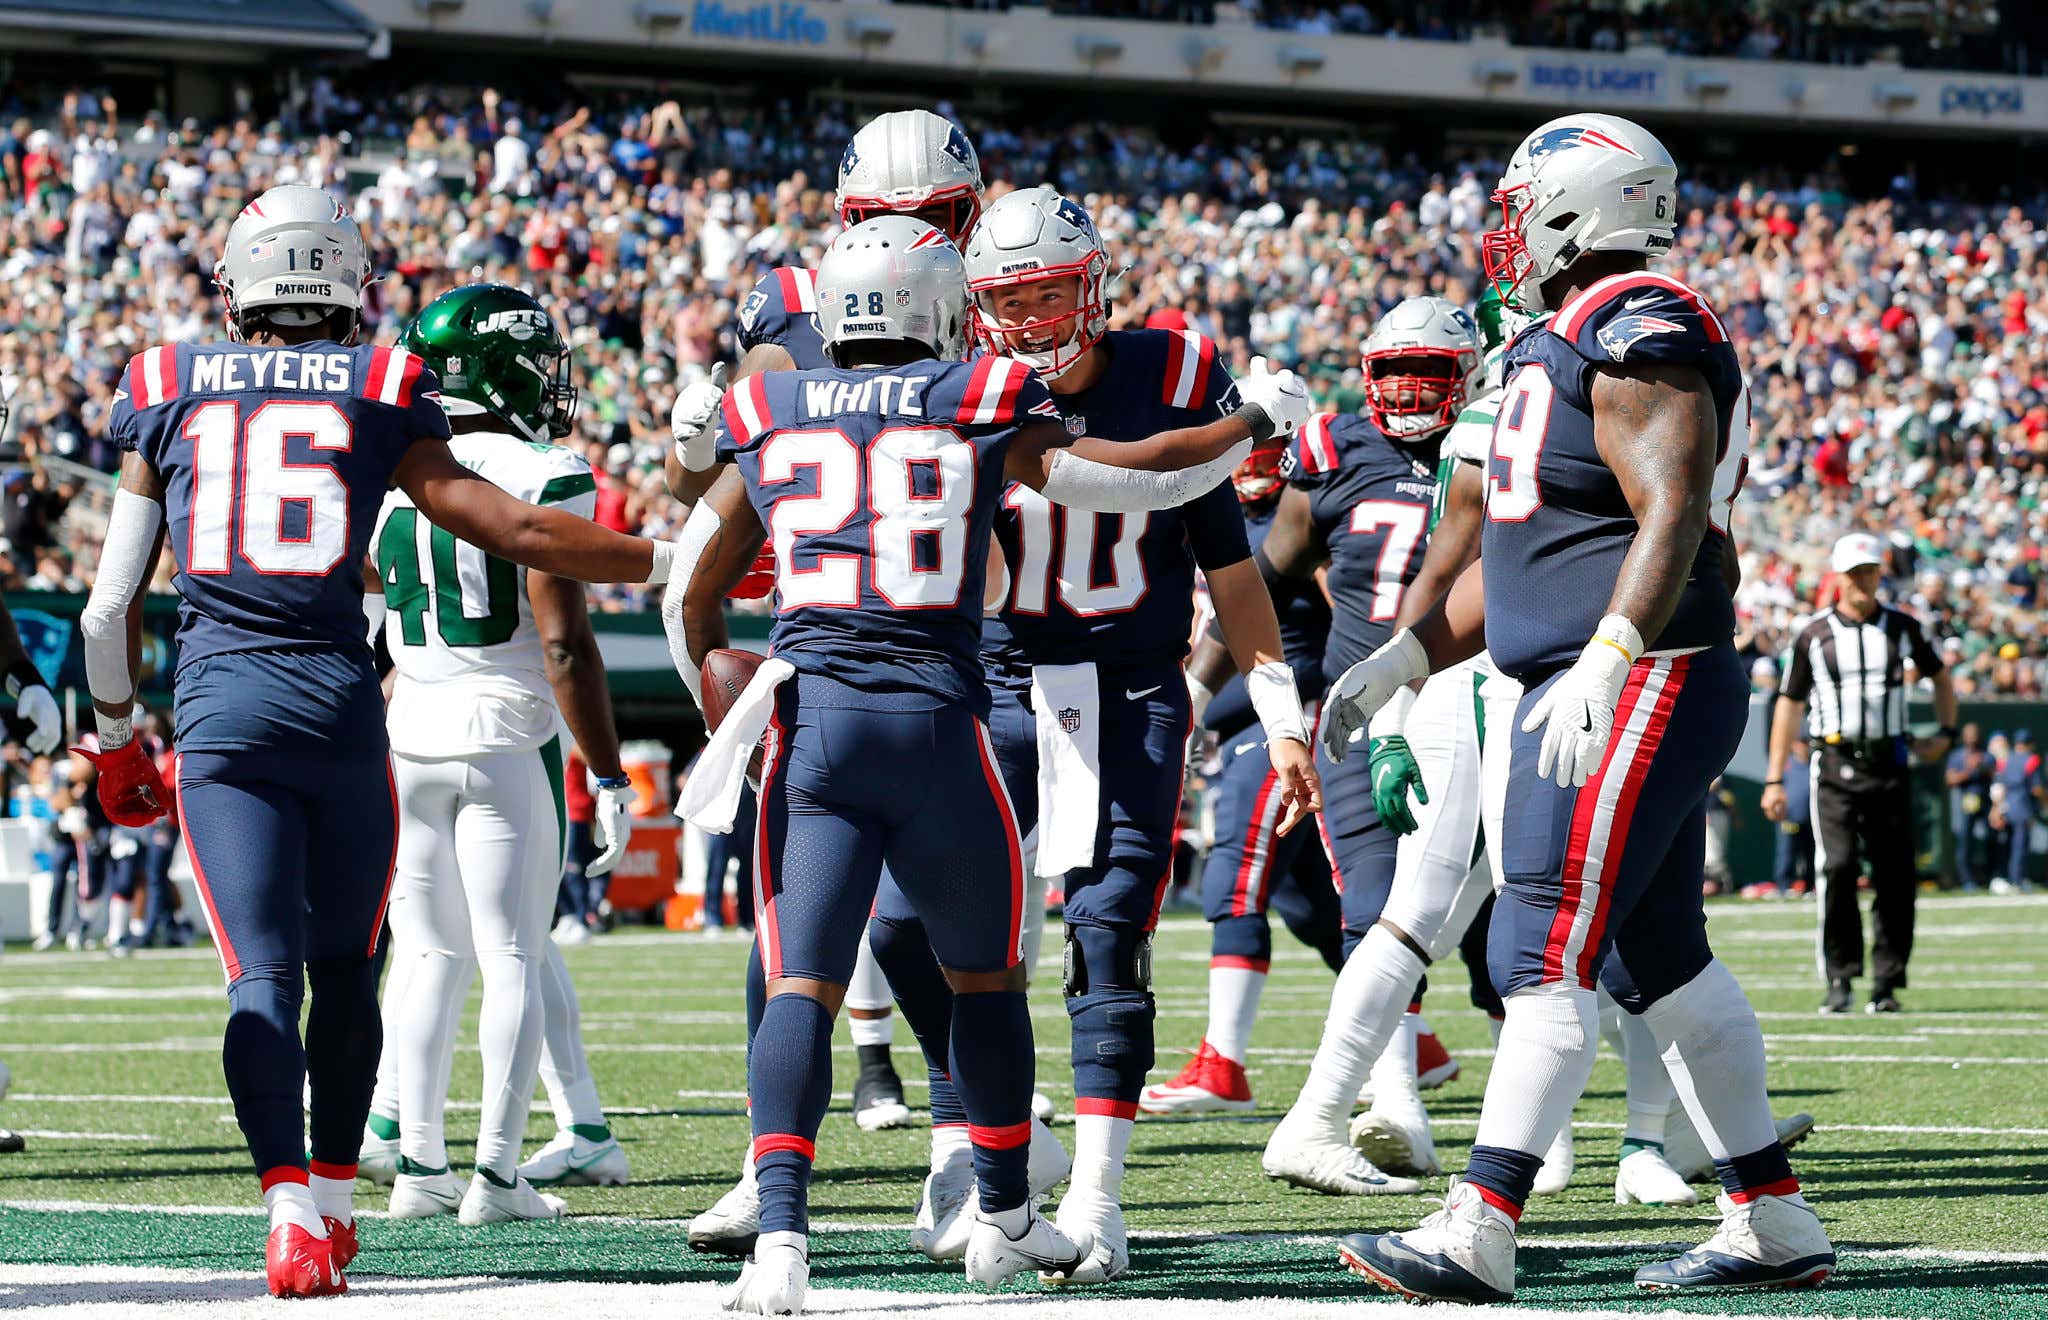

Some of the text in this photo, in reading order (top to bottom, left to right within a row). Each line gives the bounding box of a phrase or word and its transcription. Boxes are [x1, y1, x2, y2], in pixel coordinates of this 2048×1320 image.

[693, 1, 827, 45] MetLife
[1530, 64, 1658, 92] BUD LIGHT
[1940, 84, 2022, 116] pepsi
[287, 248, 324, 271] 16
[1002, 261, 1039, 275] PATRIOTS
[275, 283, 332, 297] PATRIOTS
[845, 291, 884, 318] 28
[476, 309, 549, 335] JETS
[843, 322, 886, 334] PATRIOTS
[191, 351, 351, 393] MEYERS
[805, 375, 929, 419] WHITE
[181, 399, 354, 578] 16
[757, 424, 979, 614] 28
[1003, 481, 1151, 619] 10
[378, 506, 521, 648] 40
